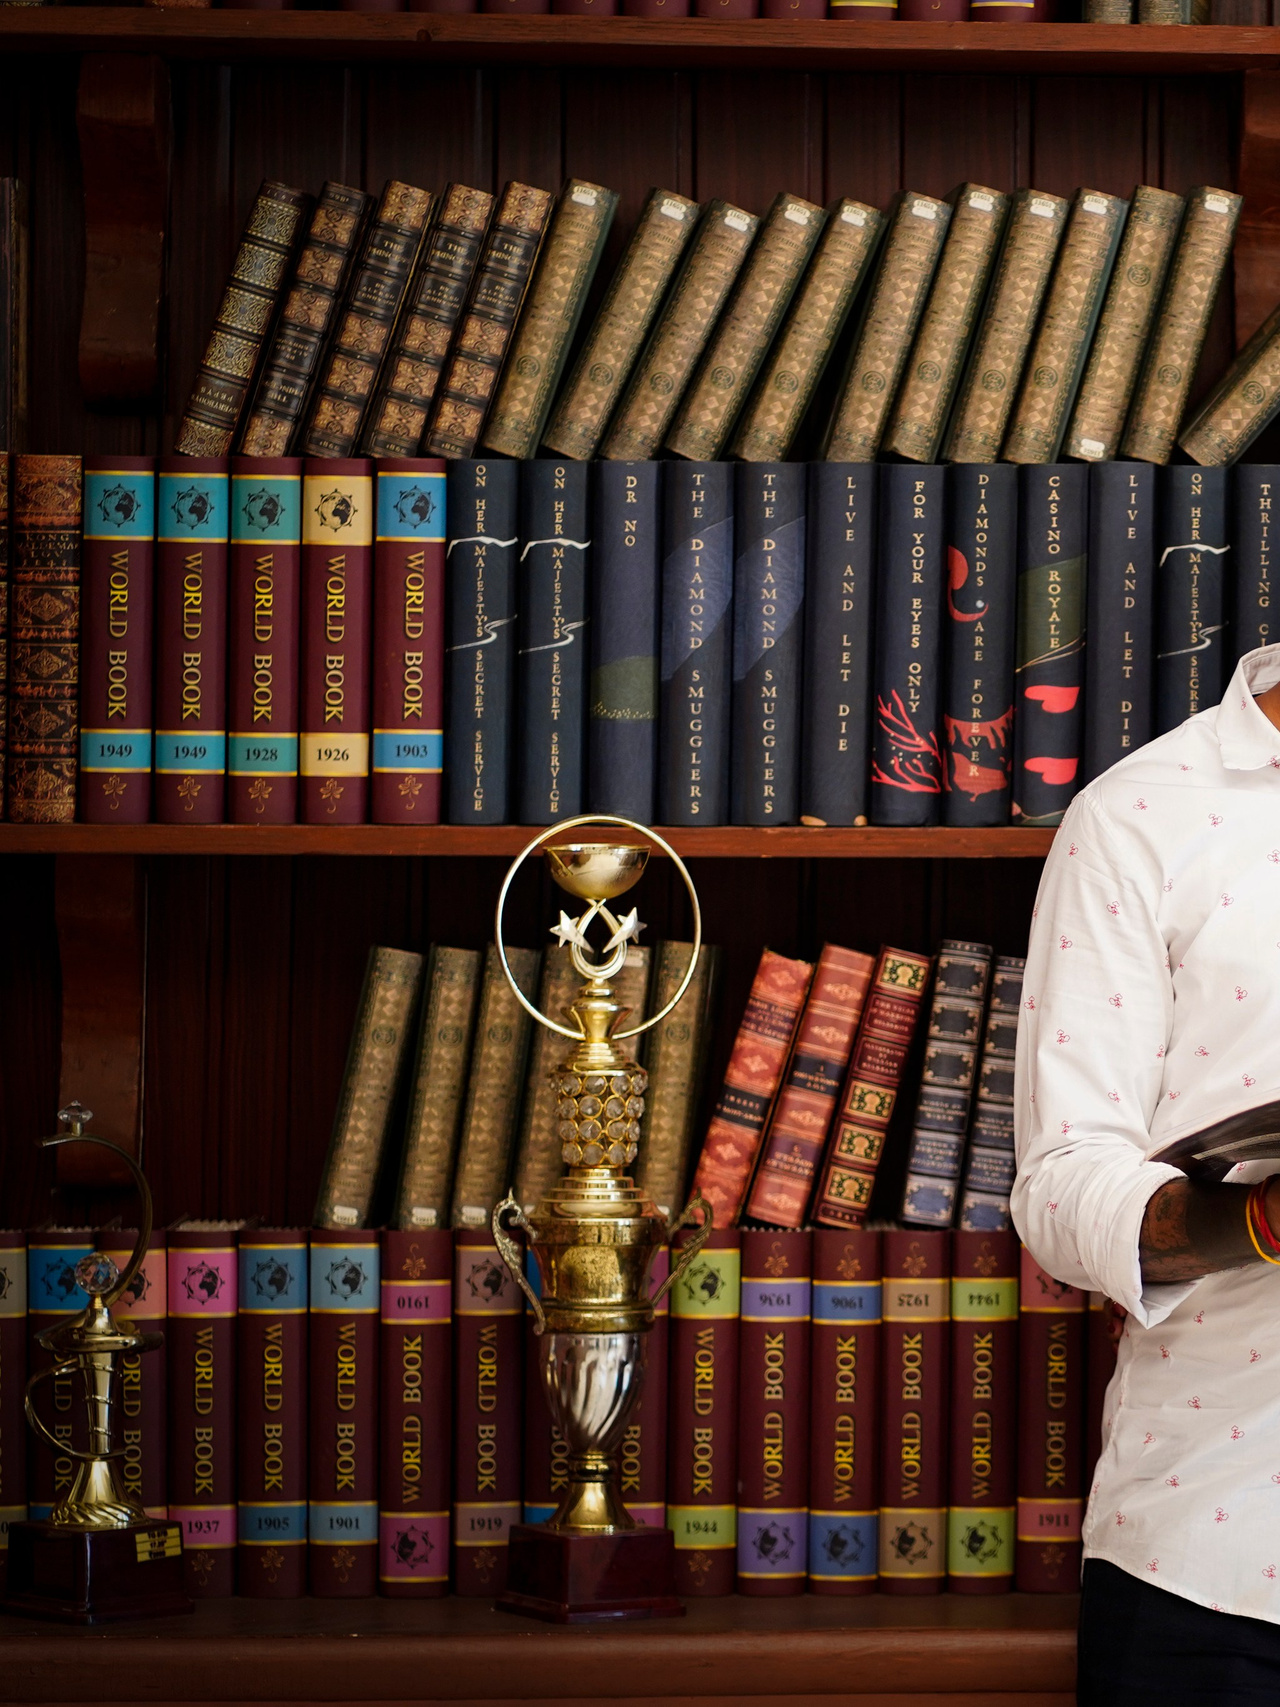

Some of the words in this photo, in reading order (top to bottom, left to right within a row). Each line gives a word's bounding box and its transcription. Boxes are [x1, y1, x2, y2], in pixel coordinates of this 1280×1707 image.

[199, 385, 234, 402] PEPYS
[475, 464, 487, 488] ON
[554, 466, 566, 489] ON
[625, 475, 638, 503] DR
[691, 473, 706, 519] THE
[763, 473, 777, 519] THE
[845, 476, 857, 542] LIVE
[913, 480, 926, 519] FOR
[1127, 474, 1139, 539] LIVE
[1191, 473, 1203, 495] ON
[475, 499, 487, 534] HER
[554, 500, 565, 536] HER
[624, 519, 638, 547] NO
[975, 474, 990, 587] DIAMONDS
[1047, 475, 1061, 555] CASINO
[1191, 506, 1202, 541] HER
[1258, 483, 1272, 608] THRILLING
[475, 545, 487, 637] MAJESTY'S
[842, 564, 855, 612] AND
[911, 532, 925, 584] YOUR
[1124, 562, 1137, 609] AND
[109, 549, 129, 639] WORLD
[183, 551, 203, 640] WORLD
[254, 553, 274, 642] WORLD
[326, 553, 346, 642] WORLD
[405, 550, 425, 639] WORLD
[552, 547, 565, 639] MAJESTY'S
[689, 539, 704, 649] DIAMOND
[762, 539, 776, 649] DIAMOND
[910, 598, 923, 649] EYES
[1049, 570, 1060, 648] ROYALE
[1190, 552, 1201, 644] MAJESTY'S
[840, 634, 852, 682] LET
[974, 621, 985, 662] ARE
[1122, 631, 1134, 679] LET
[108, 650, 128, 718] BOOK
[182, 651, 202, 720] BOOK
[253, 653, 273, 722] BOOK
[325, 654, 345, 723] BOOK
[404, 650, 424, 719] BOOK
[476, 650, 484, 718] SECRET
[551, 652, 560, 720] SECRET
[907, 662, 922, 713] ONLY
[1190, 656, 1199, 717] SECRE
[99, 743, 133, 758] 1949
[173, 745, 207, 760] 1949
[245, 747, 278, 762] 1928
[317, 748, 350, 761] 1926
[395, 744, 428, 758] 1903
[688, 669, 705, 815] SMUGGLERS
[761, 669, 778, 814] SMUGGLERS
[838, 704, 850, 752] DIE
[969, 680, 983, 777] FOREVER
[1121, 700, 1133, 748] DIE
[473, 730, 484, 812] SERVICE
[549, 732, 560, 813] SERVICE
[396, 1296, 429, 1309] 1910
[758, 1293, 791, 1307] 1936
[831, 1296, 864, 1310] 1906
[897, 1293, 930, 1307] 1925
[968, 1293, 1000, 1305] 1944
[123, 1352, 141, 1417] ORLD
[194, 1326, 214, 1416] WORLD
[264, 1323, 283, 1412] WORLD
[337, 1322, 356, 1411] WORLD
[402, 1334, 422, 1403] BOOK
[478, 1324, 497, 1412] WORLD
[694, 1327, 715, 1416] WORLD
[764, 1331, 784, 1400] BOOK
[835, 1335, 856, 1403] BOOK
[902, 1332, 922, 1400] BOOK
[972, 1332, 993, 1400] BOOK
[1047, 1322, 1068, 1409] WORLD
[123, 1430, 142, 1495] BOOK
[194, 1426, 214, 1494] BOOK
[264, 1422, 284, 1491] BOOK
[336, 1422, 356, 1491] BOOK
[402, 1415, 422, 1504] WORLD
[477, 1424, 497, 1492] BOOK
[551, 1426, 569, 1492] BOOK
[621, 1426, 641, 1492] BOOK
[693, 1427, 714, 1495] BOOK
[763, 1412, 783, 1501] WORLD
[834, 1415, 855, 1502] WORLD
[901, 1412, 922, 1500] WORLD
[971, 1411, 992, 1499] WORLD
[1045, 1420, 1066, 1488] BOOK
[187, 1520, 220, 1535] 1937
[257, 1518, 289, 1531] 1905
[329, 1517, 359, 1530] 1901
[470, 1517, 503, 1532] 1919
[685, 1520, 718, 1535] 1944
[1038, 1514, 1068, 1526] 1911
